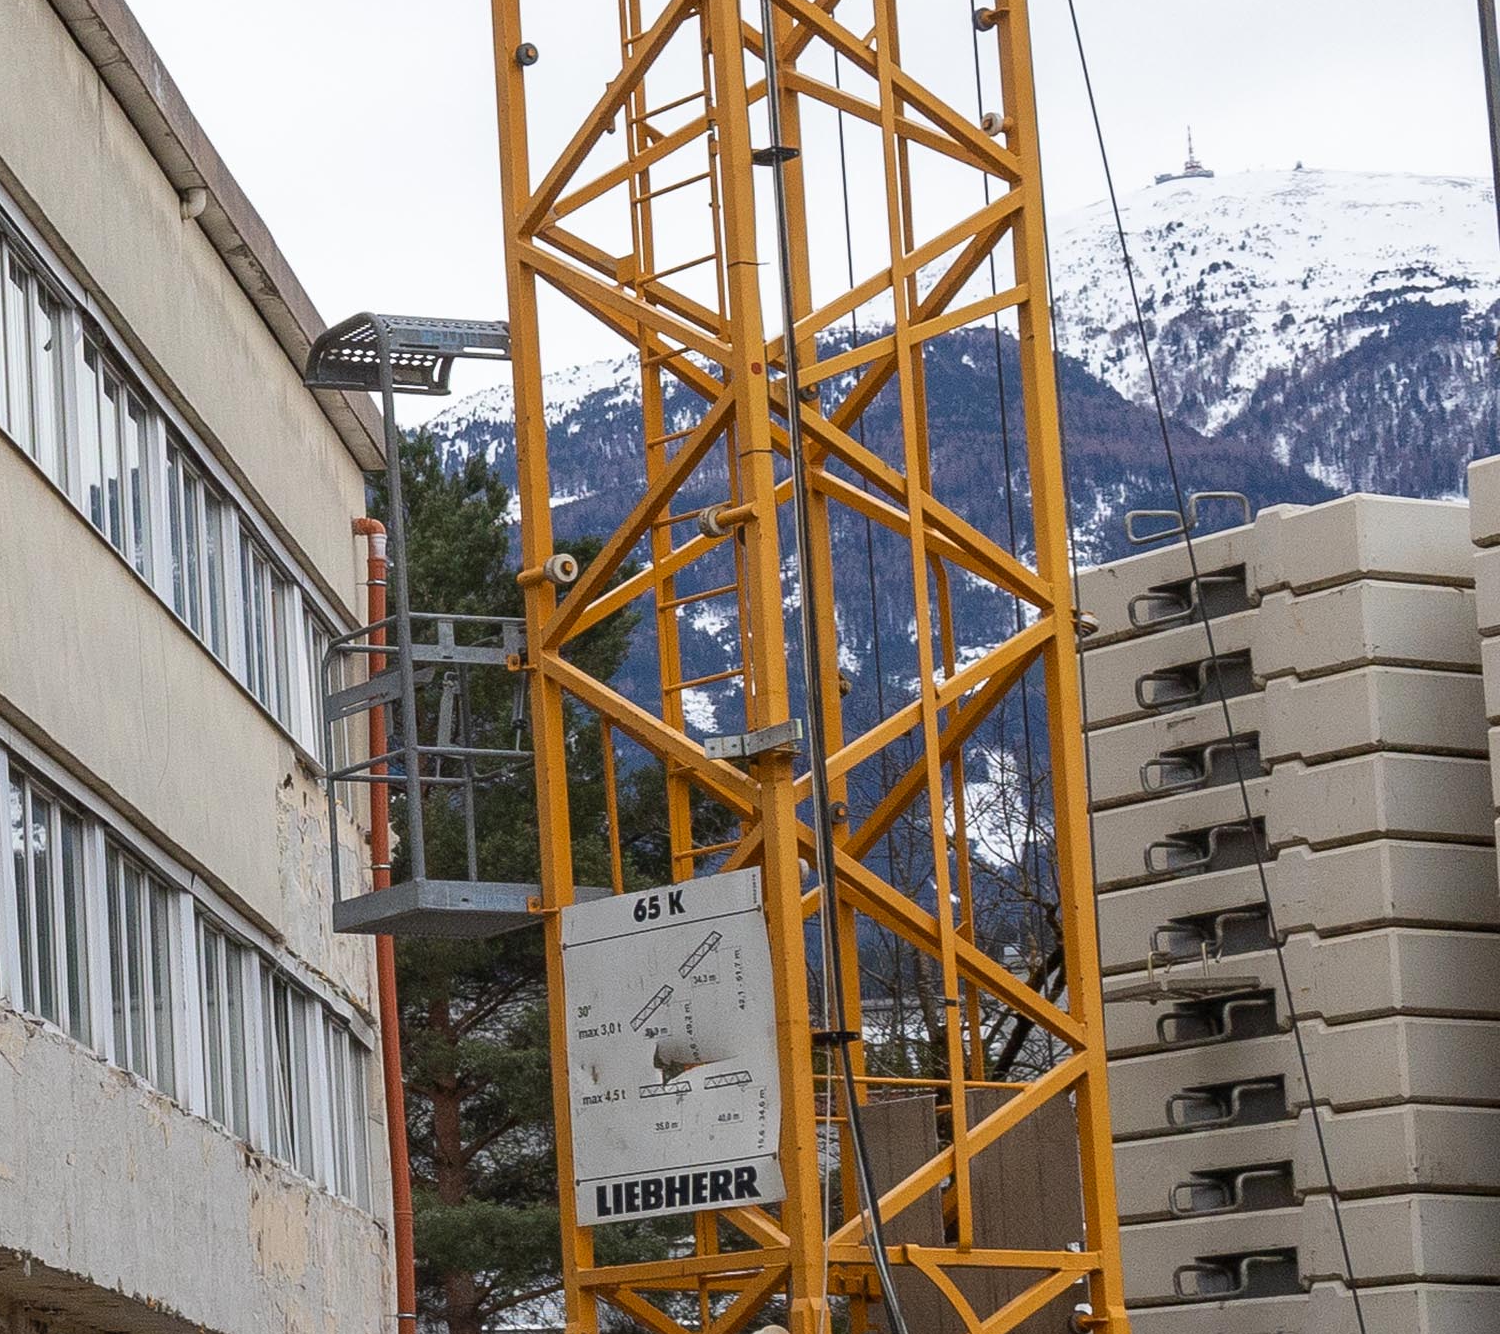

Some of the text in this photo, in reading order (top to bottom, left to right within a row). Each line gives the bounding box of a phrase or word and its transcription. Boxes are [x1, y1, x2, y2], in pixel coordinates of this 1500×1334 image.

[633, 890, 686, 922] 65 K
[579, 1028, 599, 1040] max
[601, 1022, 615, 1036] 3,0
[583, 1094, 603, 1105] max
[605, 1090, 620, 1102] 4,5
[596, 1165, 762, 1217] LIEBHERR
